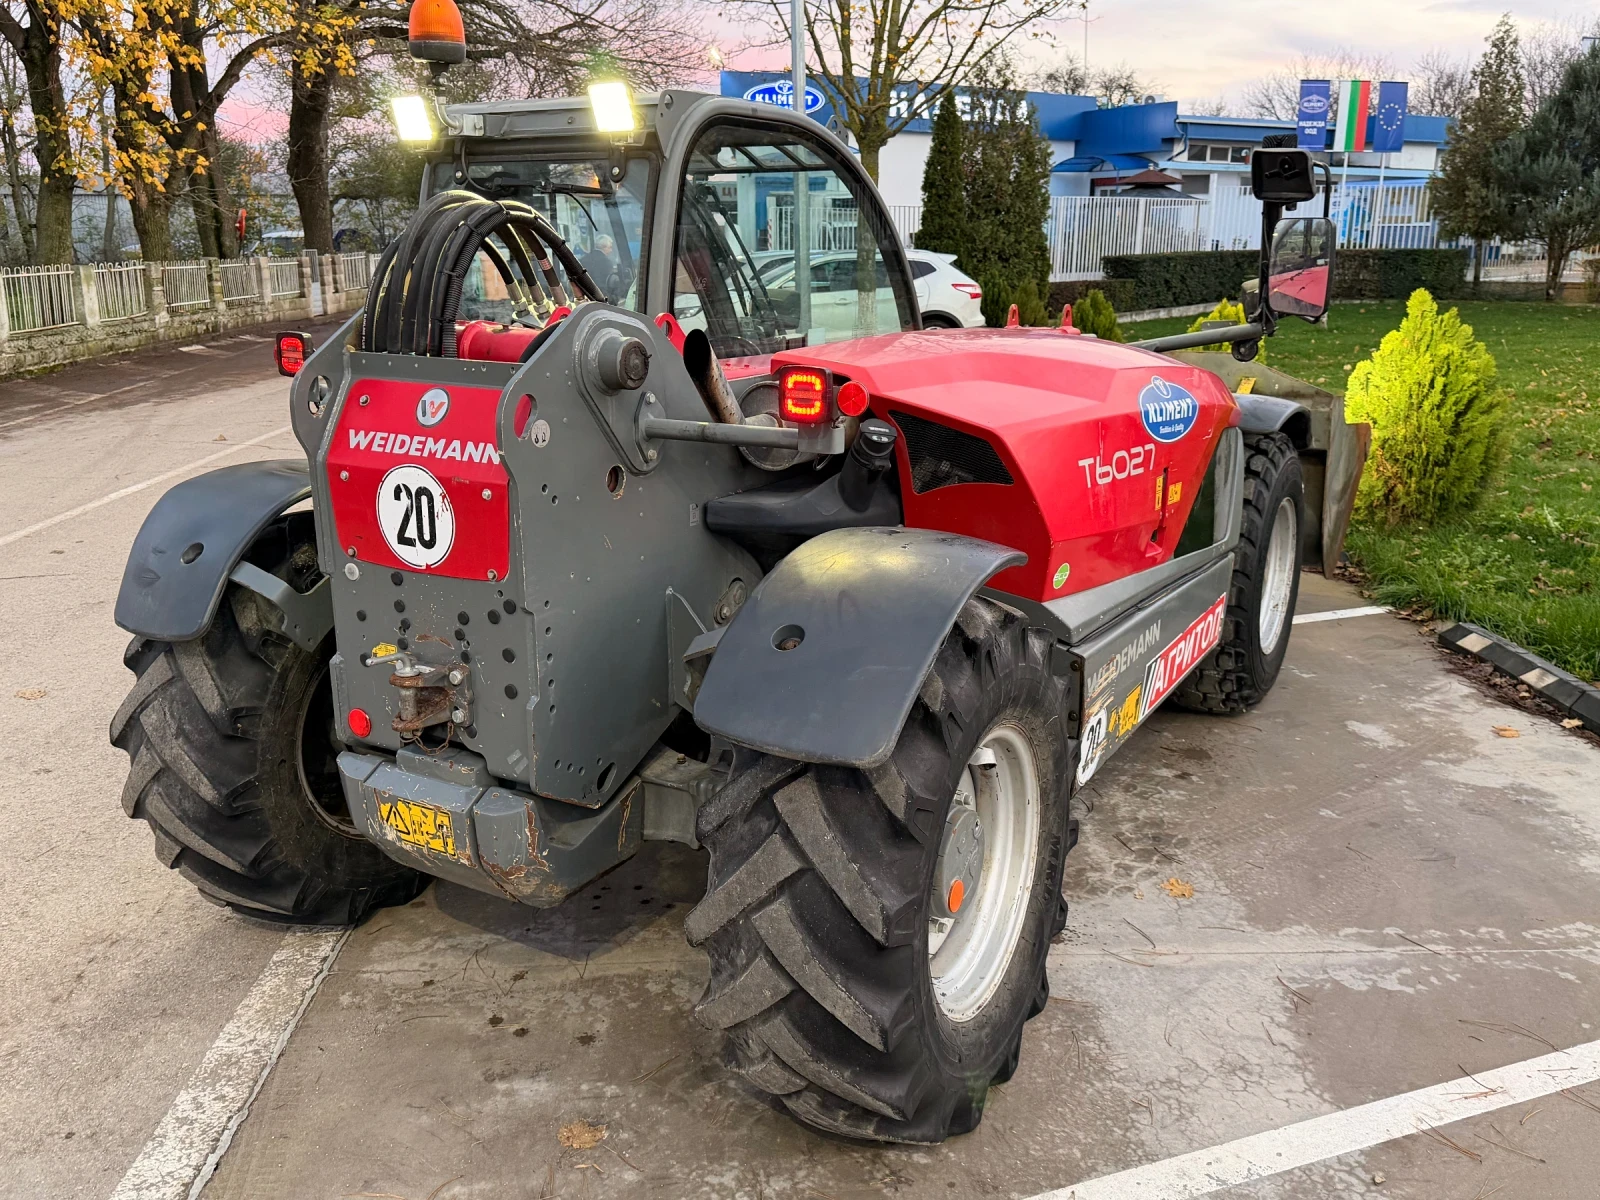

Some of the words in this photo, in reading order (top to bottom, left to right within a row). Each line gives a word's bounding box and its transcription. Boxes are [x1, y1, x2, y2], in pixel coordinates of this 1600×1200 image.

[755, 93, 814, 106] KLIMET
[1145, 397, 1193, 424] KLIMENT
[348, 429, 500, 465] WEIDEMANN
[1078, 443, 1156, 488] T6027
[393, 482, 437, 550] 20
[1151, 603, 1224, 701] АГРИТОП
